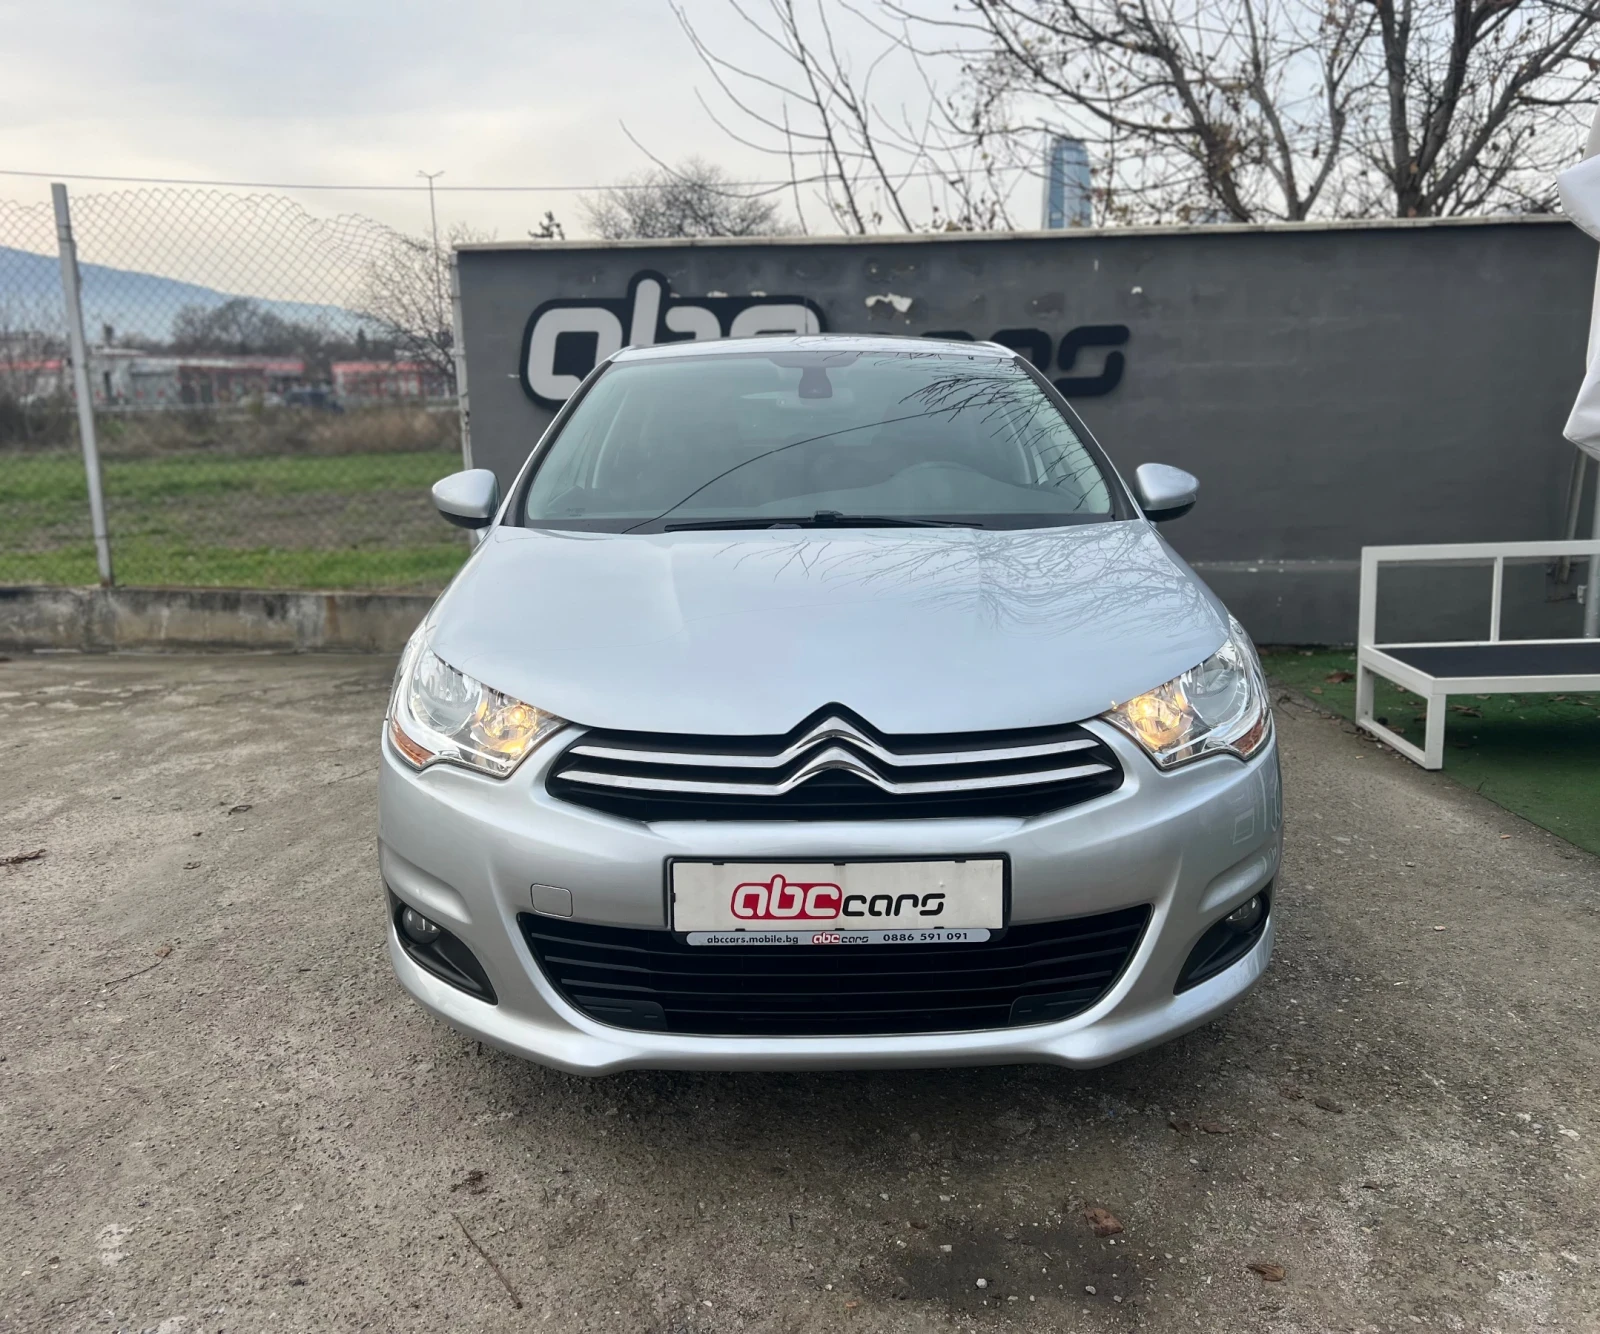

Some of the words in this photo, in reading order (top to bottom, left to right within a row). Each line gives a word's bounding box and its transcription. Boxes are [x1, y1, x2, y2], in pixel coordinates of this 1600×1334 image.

[732, 874, 842, 919] abc
[842, 893, 946, 917] cars
[706, 935, 799, 945] abccars.mobile.bg
[811, 932, 840, 945] abc
[841, 935, 869, 944] cars
[883, 933, 914, 942] 0886
[920, 932, 941, 941] 591
[946, 932, 968, 941] 091
